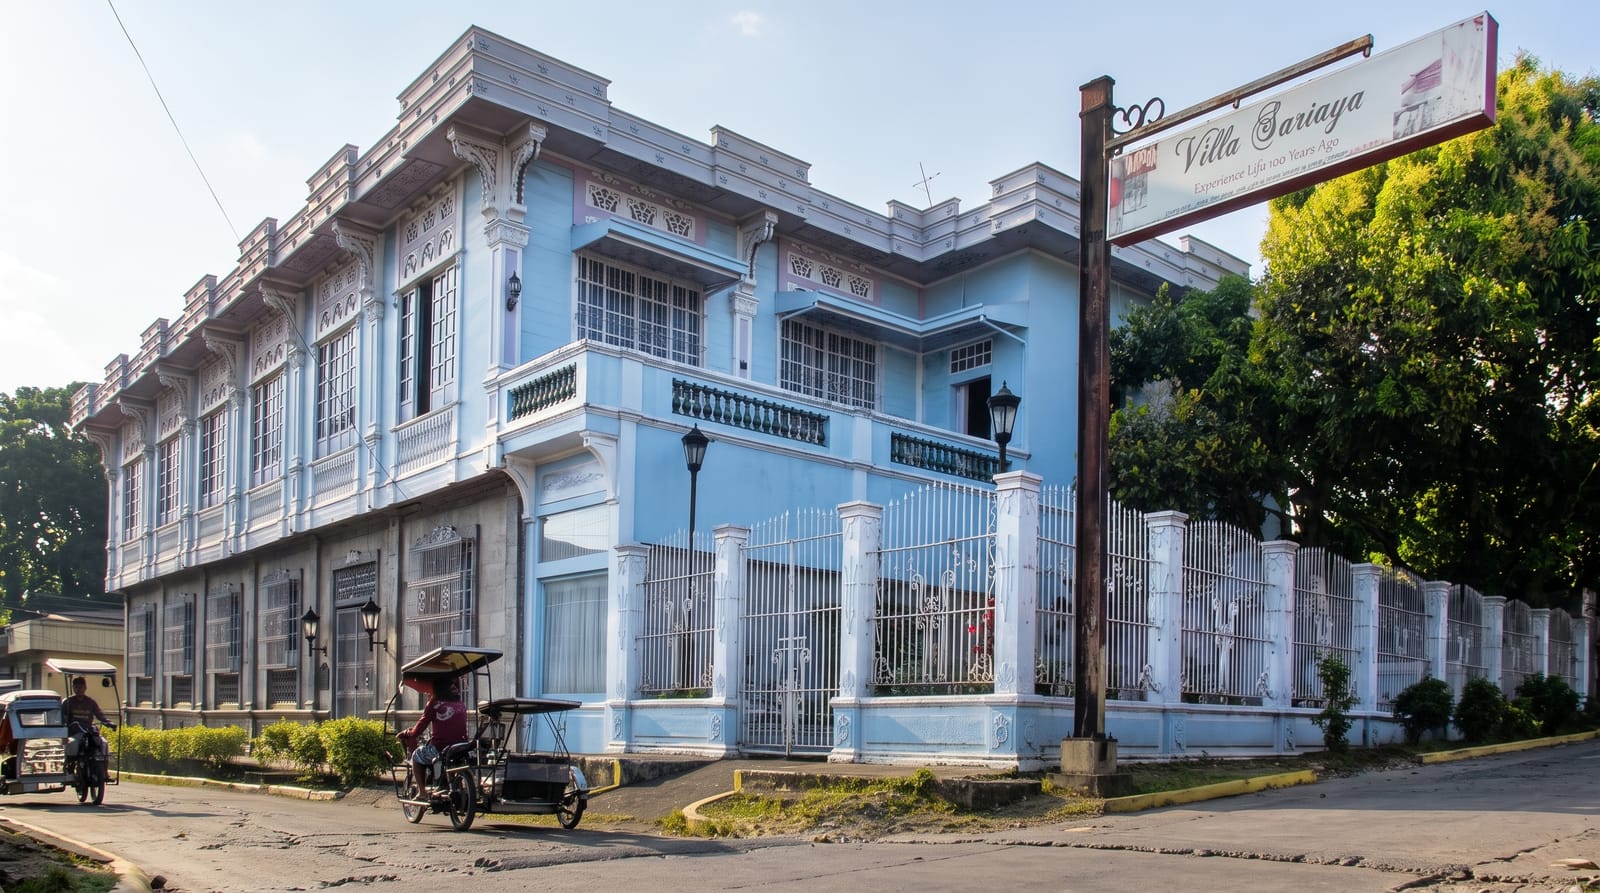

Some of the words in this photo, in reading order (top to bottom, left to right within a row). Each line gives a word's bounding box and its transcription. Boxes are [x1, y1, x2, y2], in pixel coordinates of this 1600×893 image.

[1175, 124, 1240, 174] Villa
[1251, 90, 1365, 150] Sariaya
[1194, 170, 1245, 194] Experience
[1269, 156, 1286, 168] 100
[1288, 145, 1315, 161] Years
[1318, 138, 1340, 153] Ago
